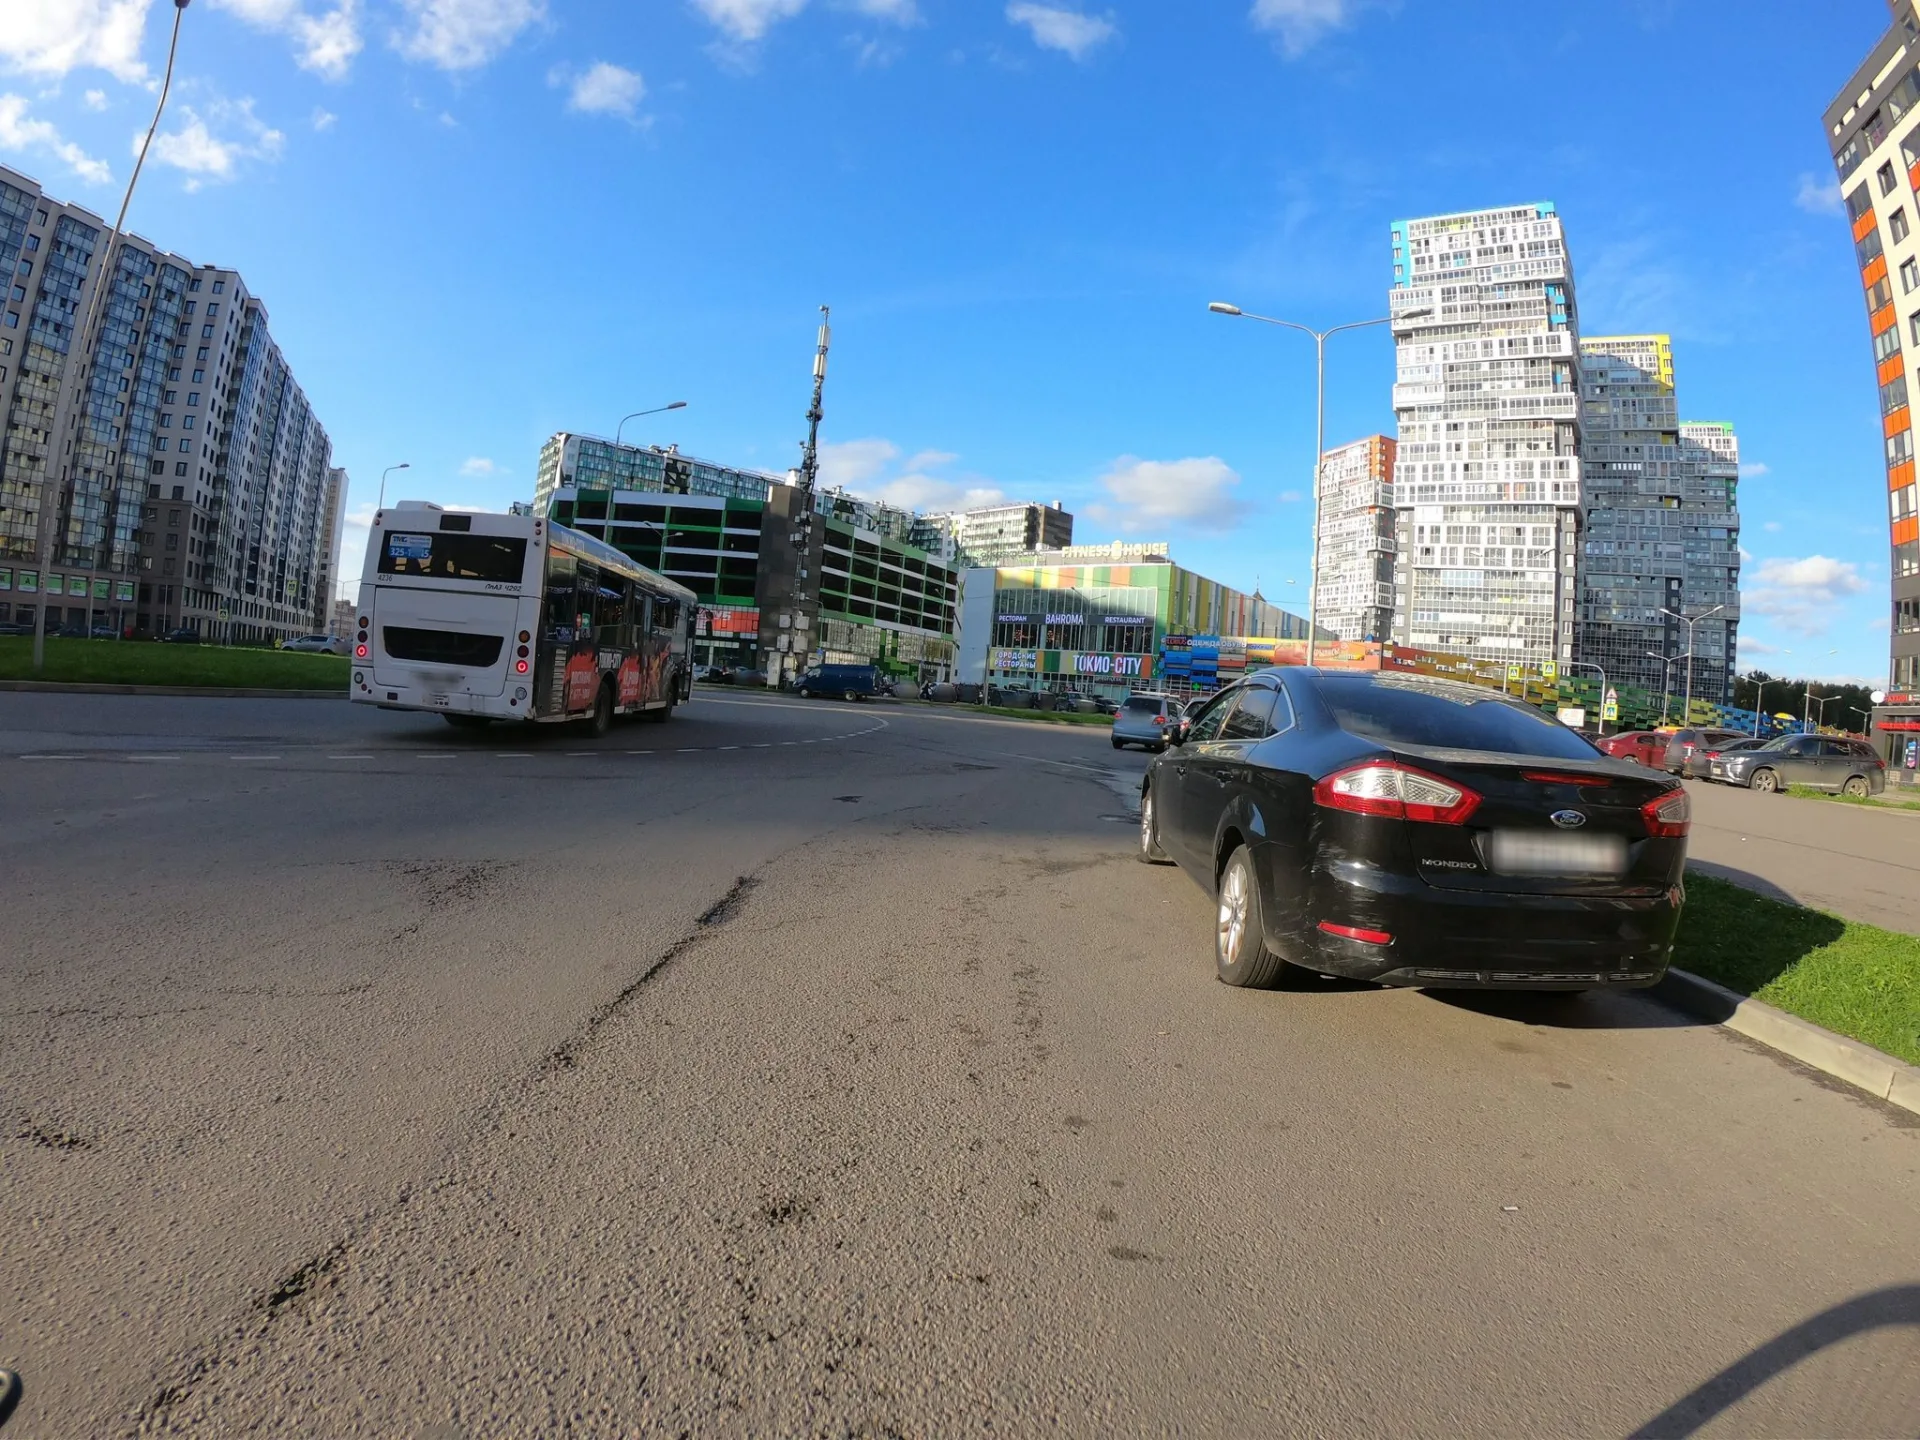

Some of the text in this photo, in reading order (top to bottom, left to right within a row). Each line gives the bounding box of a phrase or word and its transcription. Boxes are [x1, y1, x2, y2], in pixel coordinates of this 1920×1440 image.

[1061, 542, 1168, 558] FITNESS HOUSE
[504, 584, 522, 592] 4292
[1045, 613, 1084, 625] BAHROMA
[1104, 616, 1146, 624] RESTAURANT
[994, 651, 1037, 660] ГОРОДСКИЕ
[994, 659, 1036, 669] РЕСТОРАНЫ
[1559, 812, 1580, 824] Ford
[1421, 858, 1477, 870] MONDEO
